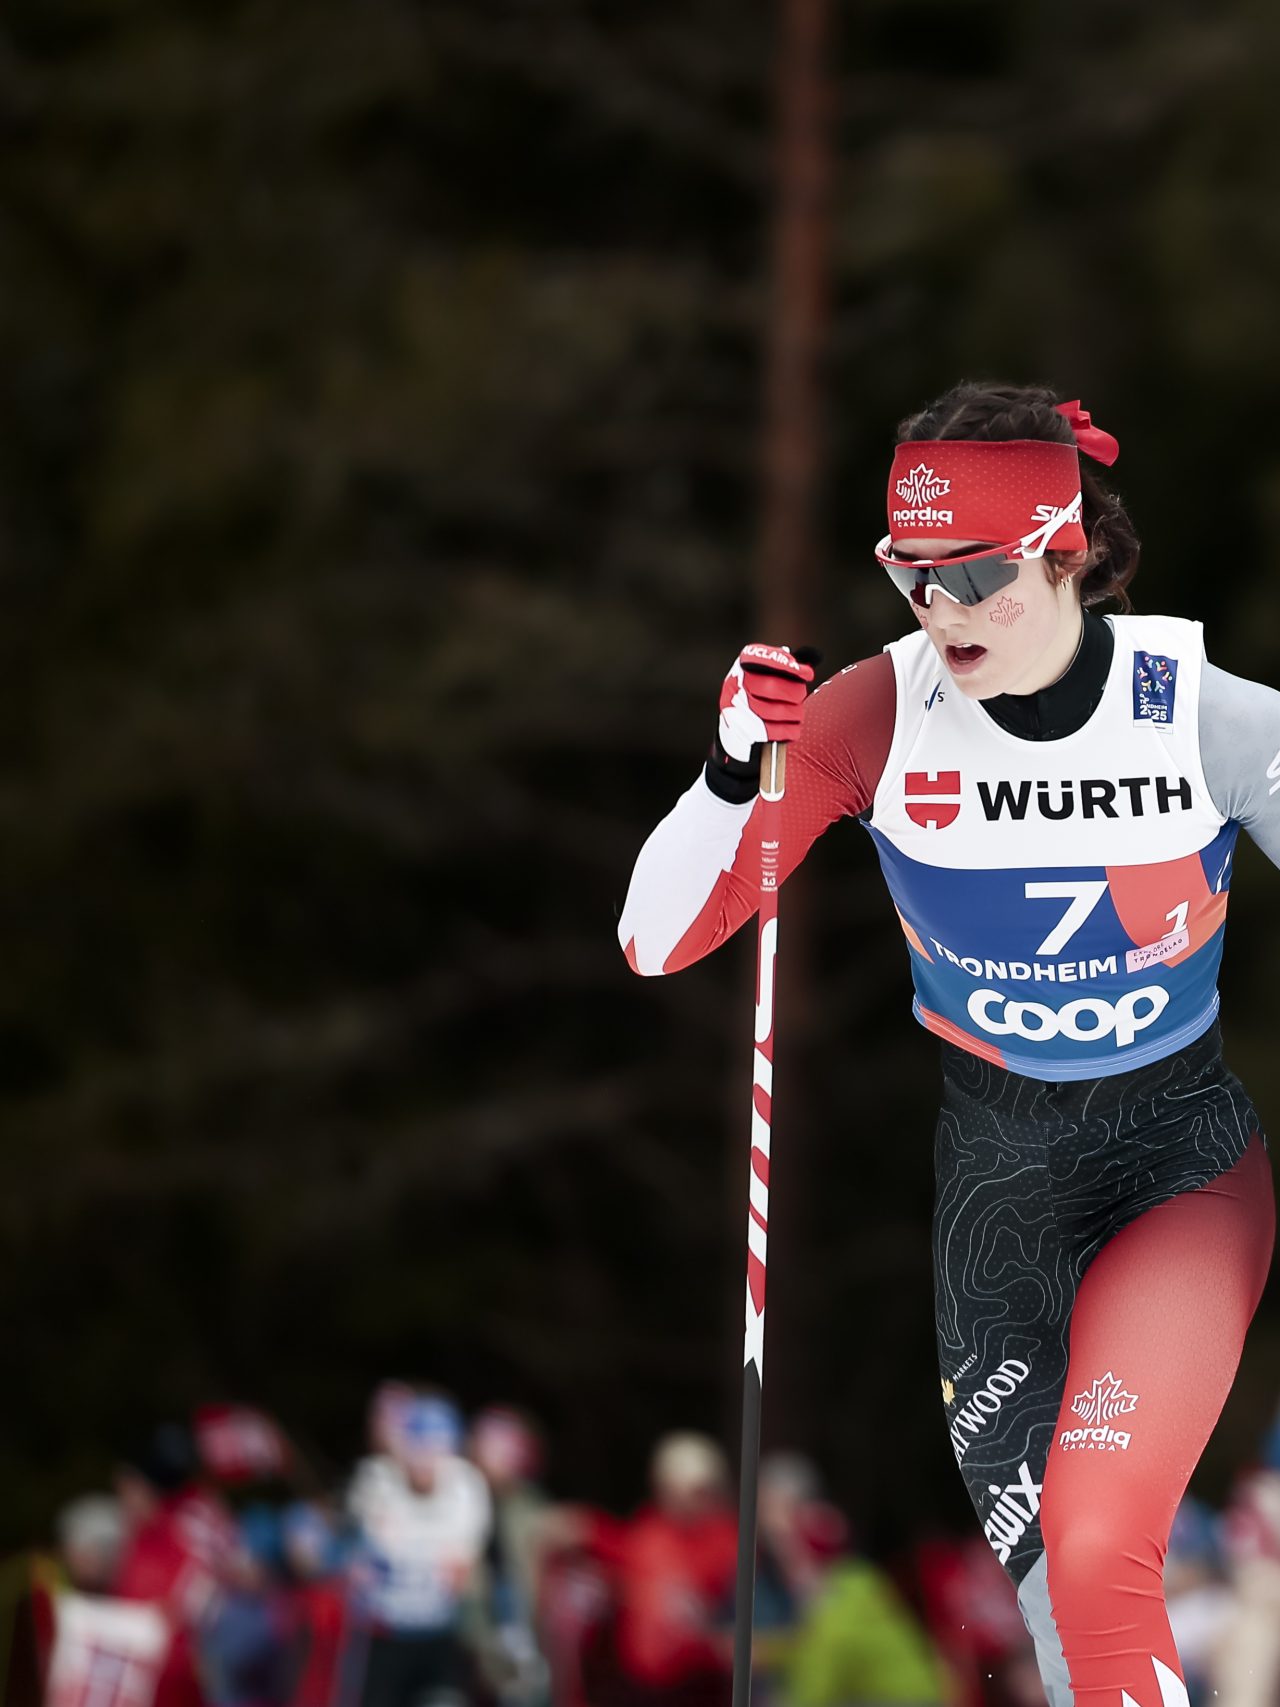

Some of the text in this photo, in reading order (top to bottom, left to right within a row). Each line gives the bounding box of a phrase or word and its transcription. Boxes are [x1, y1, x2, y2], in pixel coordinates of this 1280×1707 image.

[893, 506, 953, 525] nordiq
[976, 776, 1193, 821] WÜRTH
[1024, 880, 1110, 956] 7
[1160, 900, 1189, 940] 1
[930, 936, 1117, 982] TRONDHEIM
[967, 985, 1170, 1047] coop
[952, 1353, 978, 1382] MARKETS
[950, 1358, 1030, 1470] AYWOOD
[1059, 1424, 1132, 1450] nordiq
[1063, 1442, 1116, 1452] CANADA
